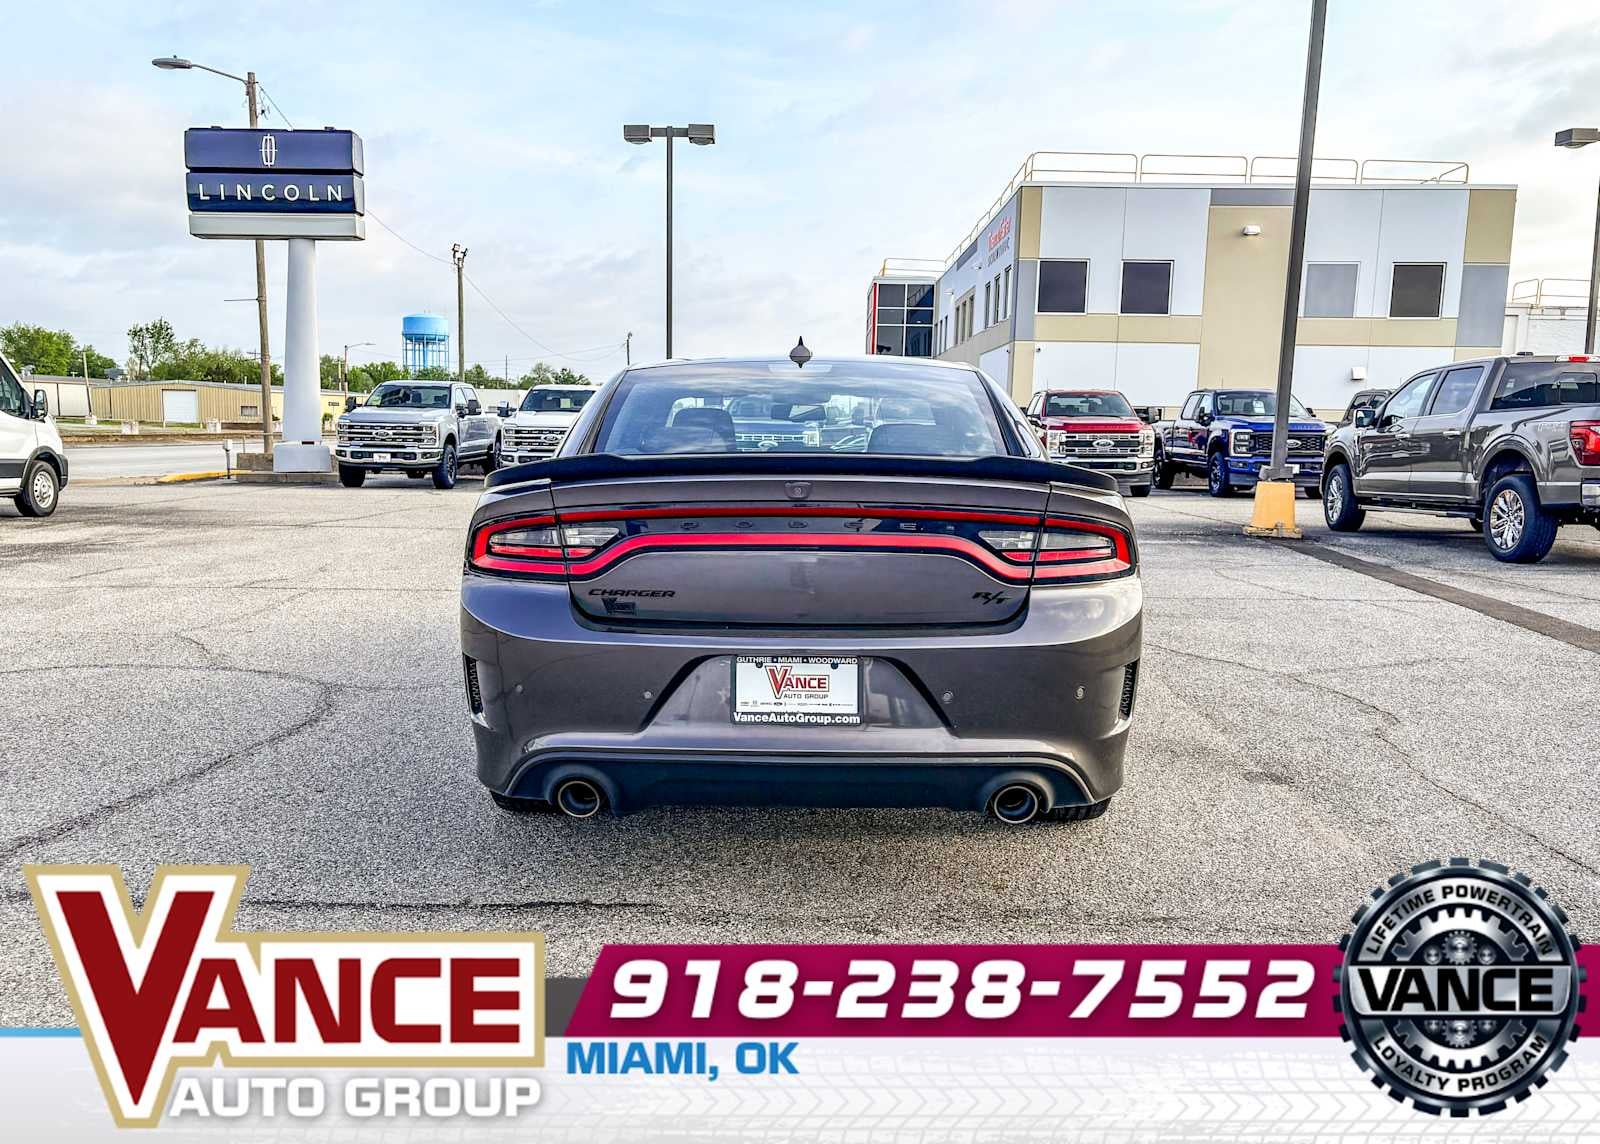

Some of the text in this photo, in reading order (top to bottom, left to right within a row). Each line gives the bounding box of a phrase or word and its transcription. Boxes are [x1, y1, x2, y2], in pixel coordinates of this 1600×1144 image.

[198, 183, 343, 202] LINCOLN
[588, 588, 676, 598] CHARGER
[972, 591, 1012, 605] R/T
[736, 656, 772, 664] GUTHRIE
[777, 656, 802, 664] MIAMI
[766, 667, 828, 697] VANCE
[733, 712, 861, 725] VanceAutoGroup.com
